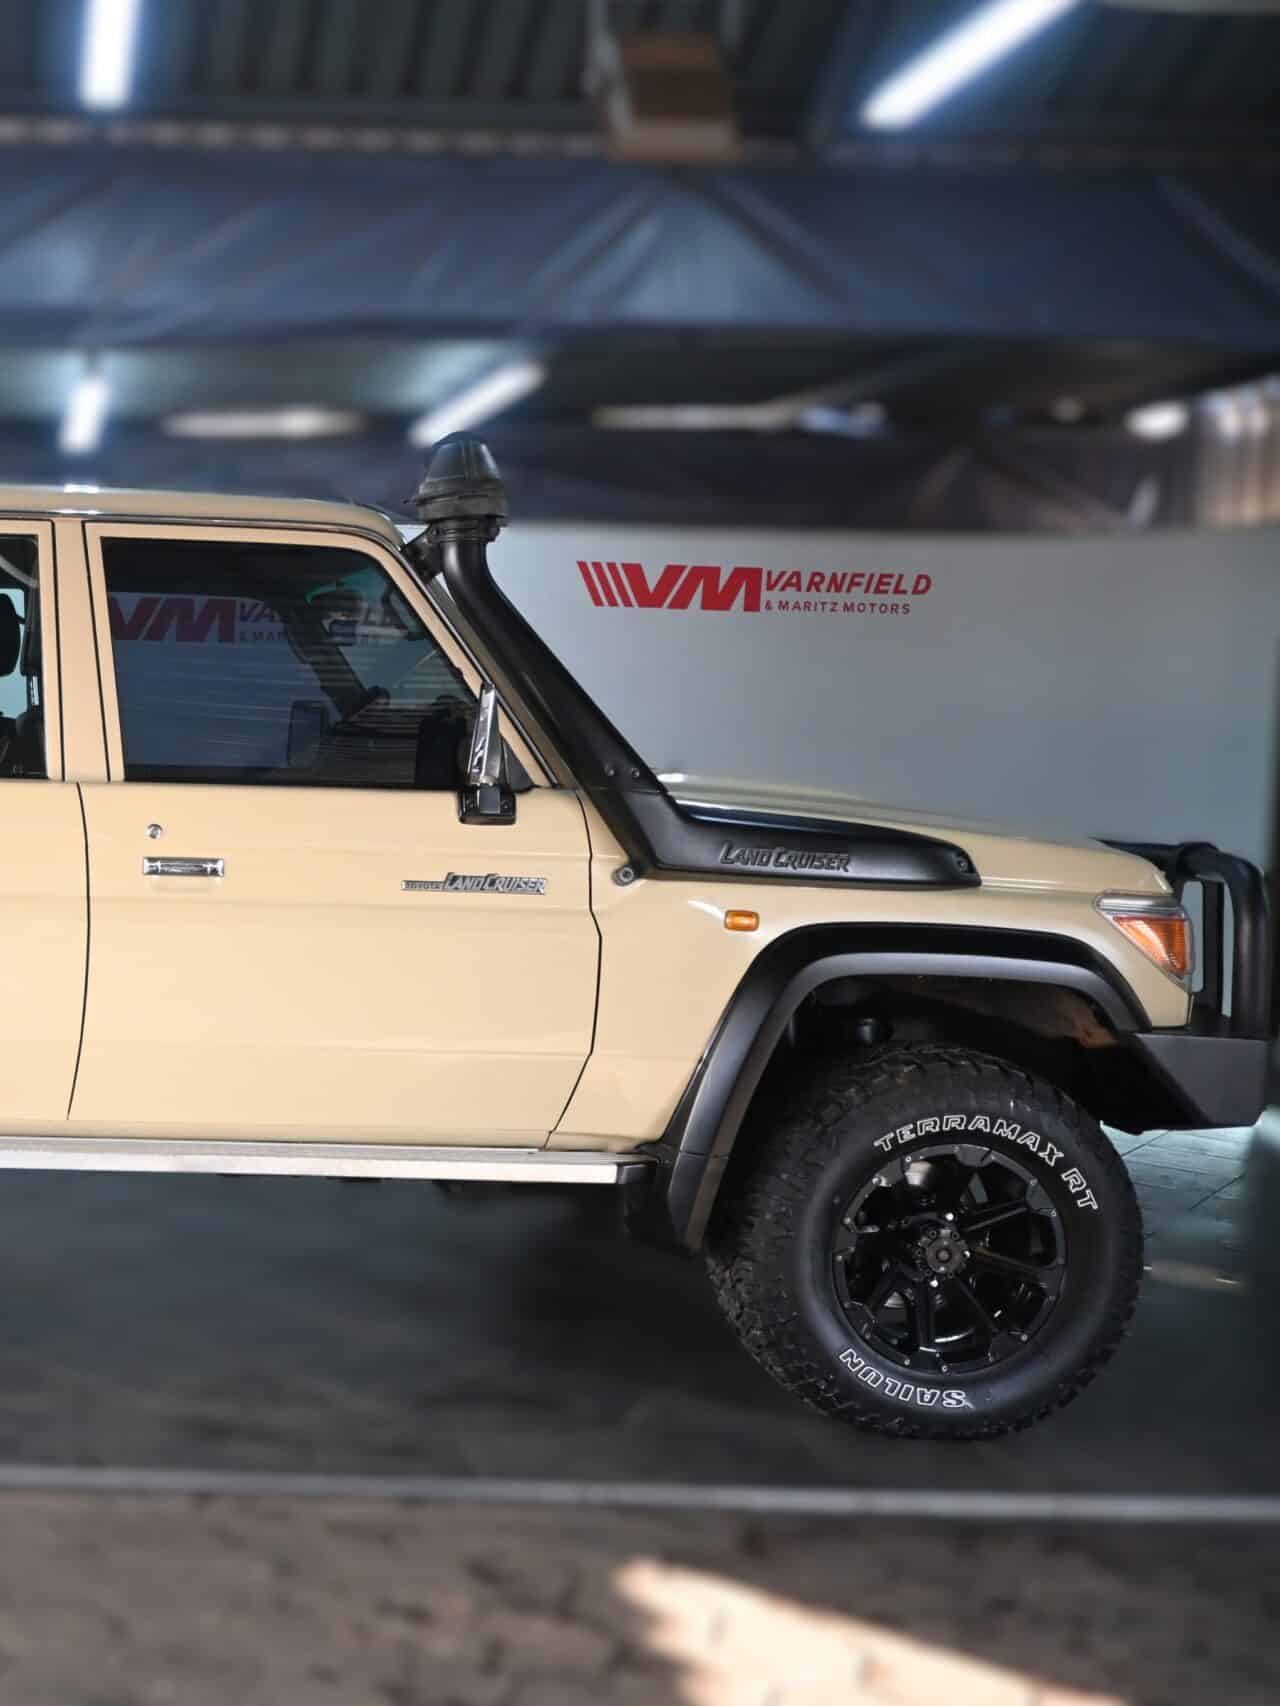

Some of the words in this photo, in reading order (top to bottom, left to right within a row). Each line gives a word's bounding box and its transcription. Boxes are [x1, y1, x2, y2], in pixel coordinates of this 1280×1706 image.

[764, 569, 933, 596] VARNFIELD
[765, 601, 774, 611] &
[777, 600, 838, 613] MARITZ
[842, 602, 911, 615] MOTORS
[873, 1114, 1065, 1167] TERRAMAX
[1061, 1168, 1099, 1213] RT
[839, 1347, 968, 1409] SAILUN
